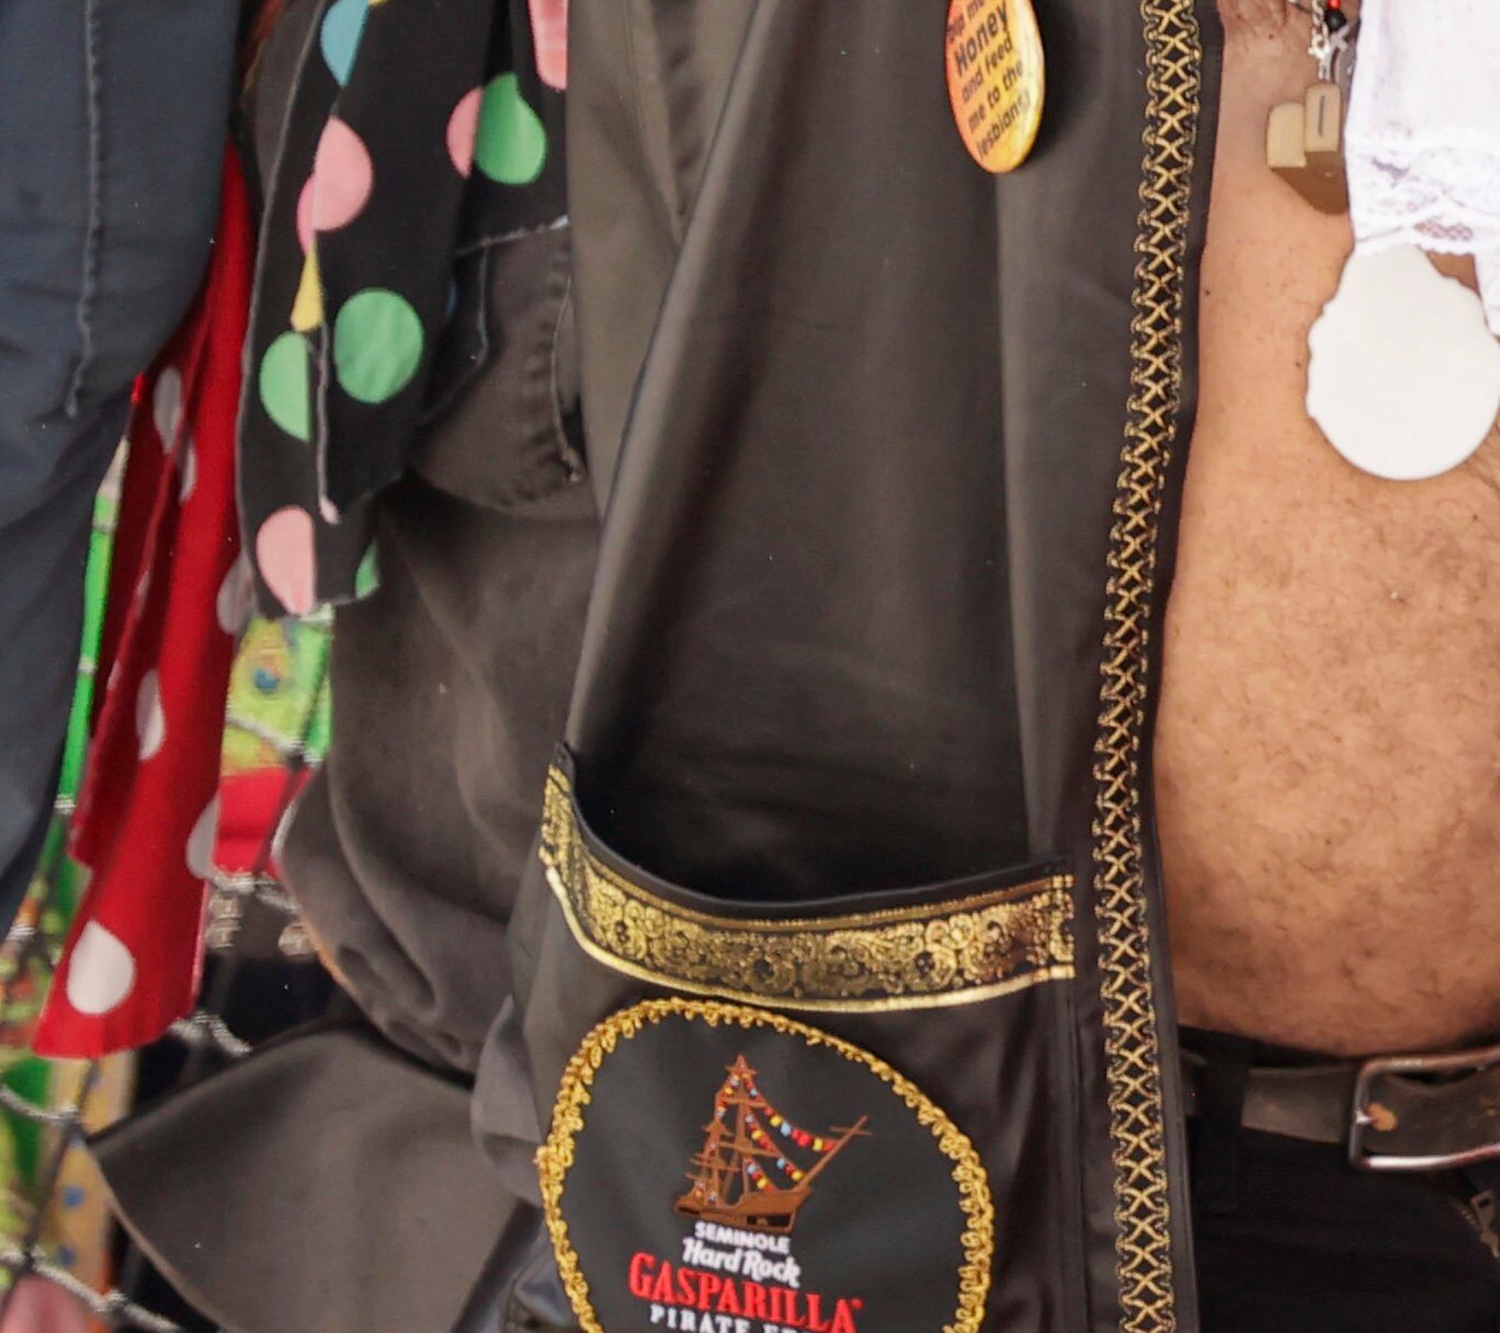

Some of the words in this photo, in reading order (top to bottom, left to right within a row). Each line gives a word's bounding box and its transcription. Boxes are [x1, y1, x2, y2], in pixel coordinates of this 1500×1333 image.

[680, 1236, 744, 1274] Hard
[741, 1249, 801, 1289] Rock
[693, 1220, 791, 1254] SEMINOLE
[627, 1250, 860, 1333] GASPARILLA
